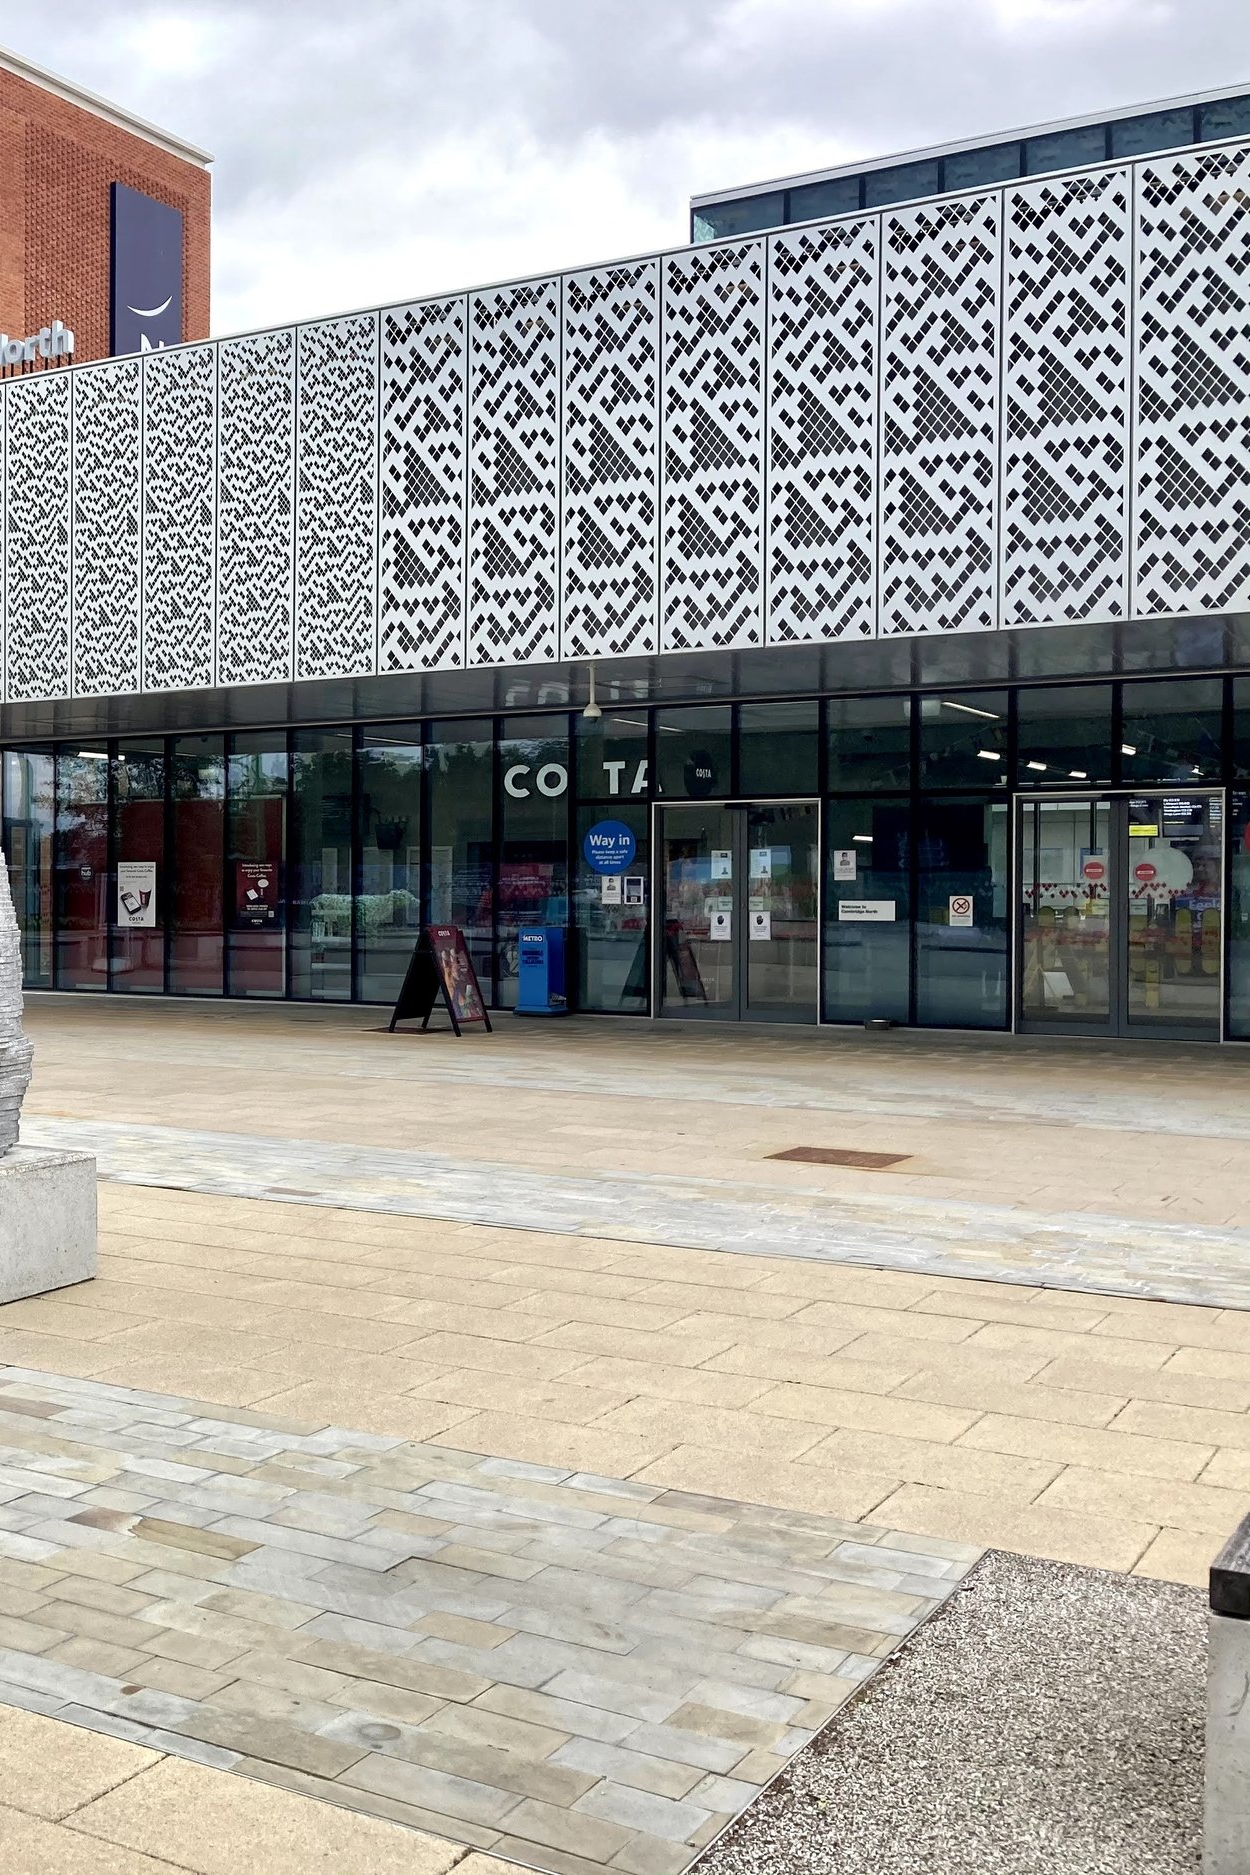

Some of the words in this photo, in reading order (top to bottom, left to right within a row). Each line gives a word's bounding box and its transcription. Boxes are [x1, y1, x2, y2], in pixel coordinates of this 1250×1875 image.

[504, 760, 663, 798] COTA
[696, 768, 712, 778] COSTA
[590, 834, 615, 848] Way
[619, 833, 630, 846] in
[523, 934, 543, 942] METRO
